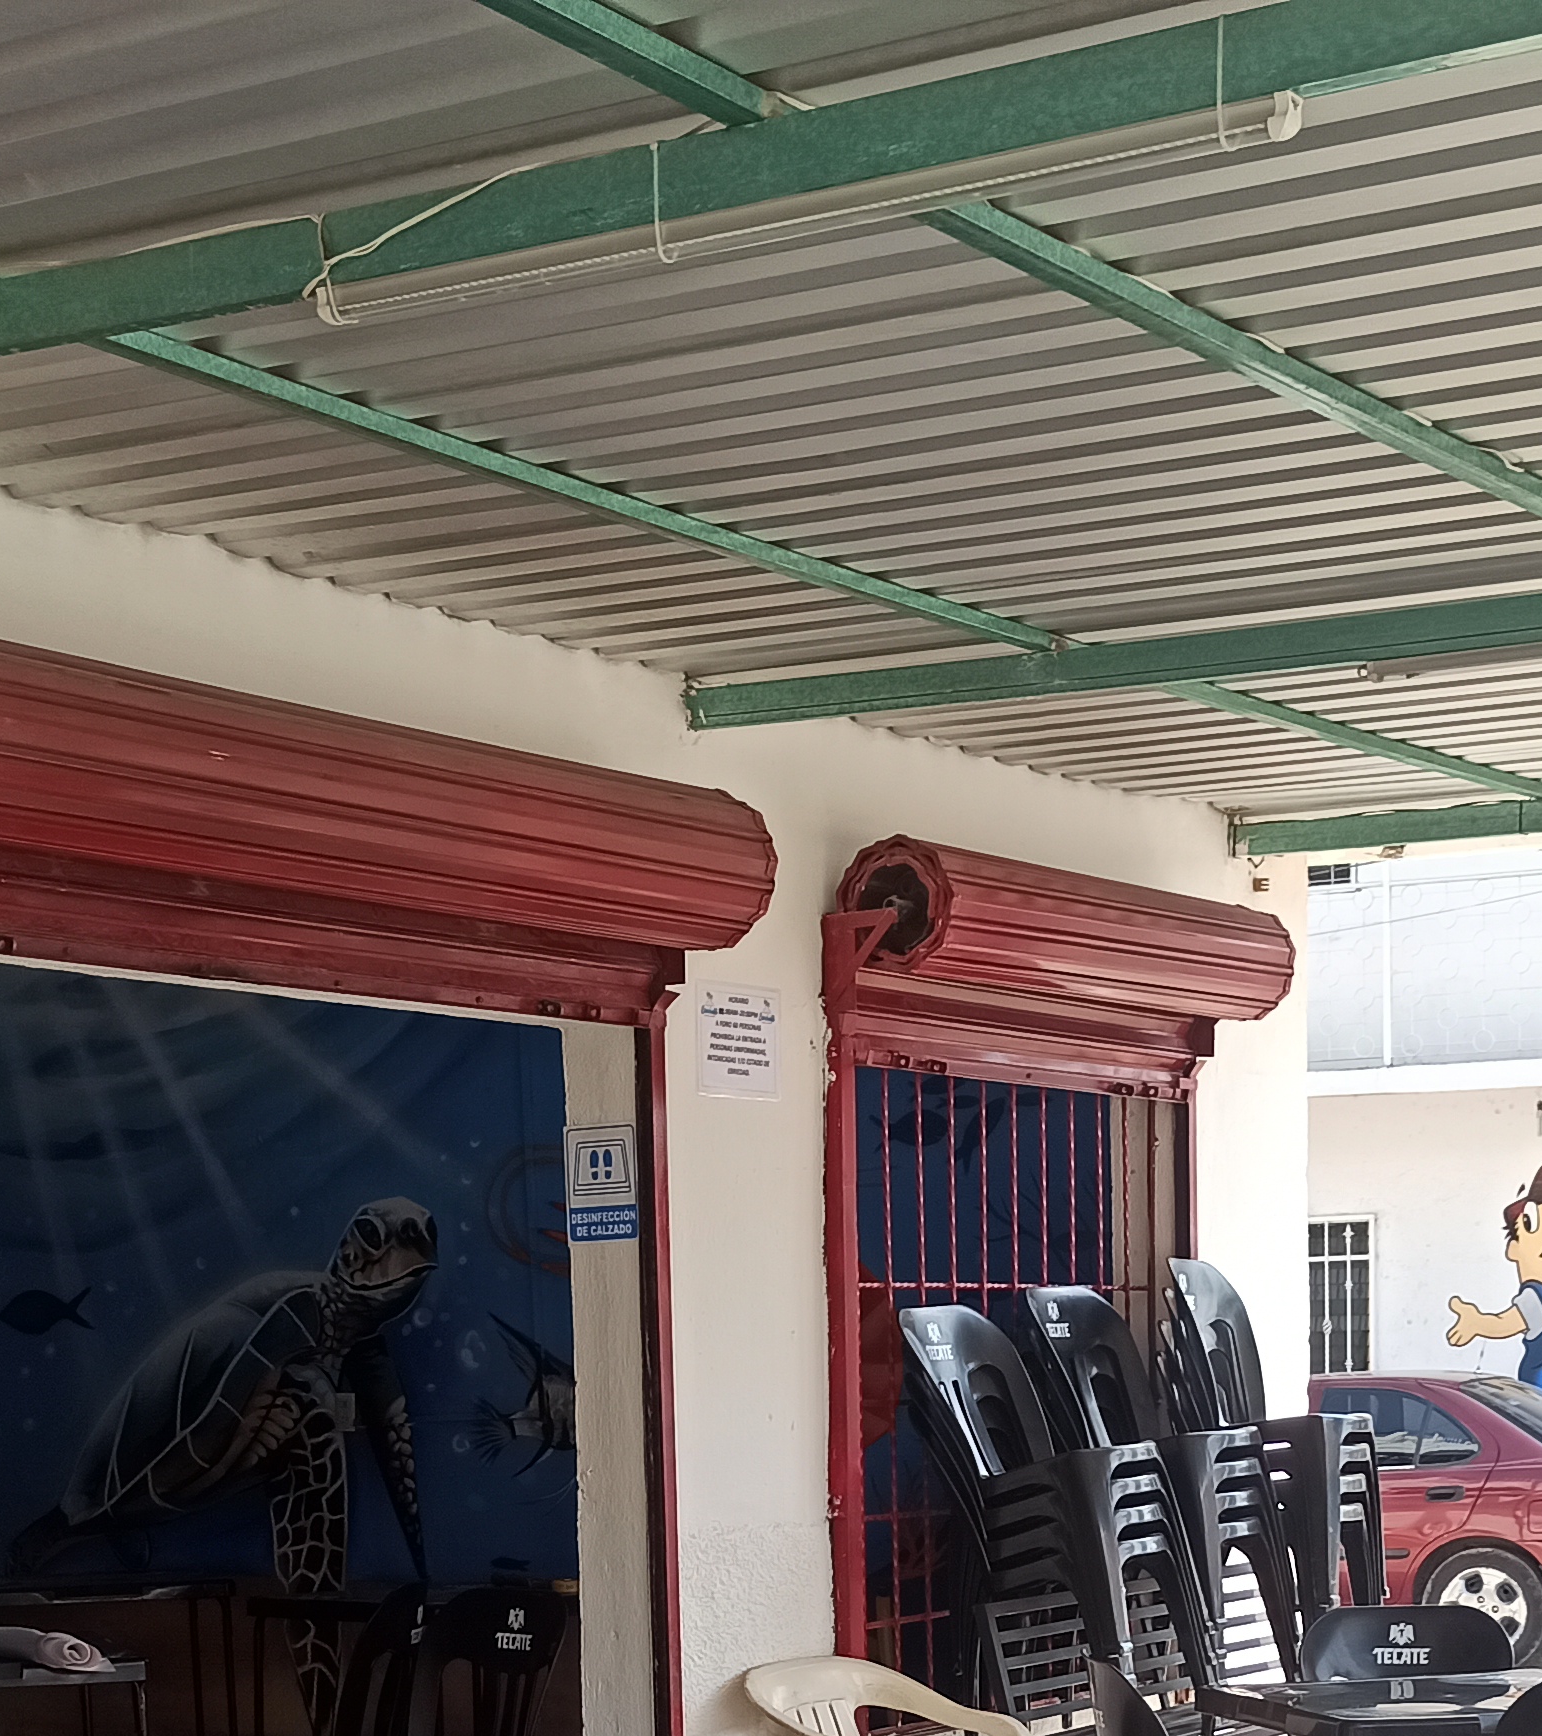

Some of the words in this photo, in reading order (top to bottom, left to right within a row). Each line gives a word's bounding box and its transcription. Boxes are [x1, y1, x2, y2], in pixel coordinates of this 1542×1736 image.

[571, 1208, 636, 1225] DESINFECCIÓN
[576, 1226, 588, 1237] DE
[590, 1223, 632, 1236] CALZADO
[495, 1632, 532, 1651] TECATE
[1372, 1647, 1431, 1665] TECATE
